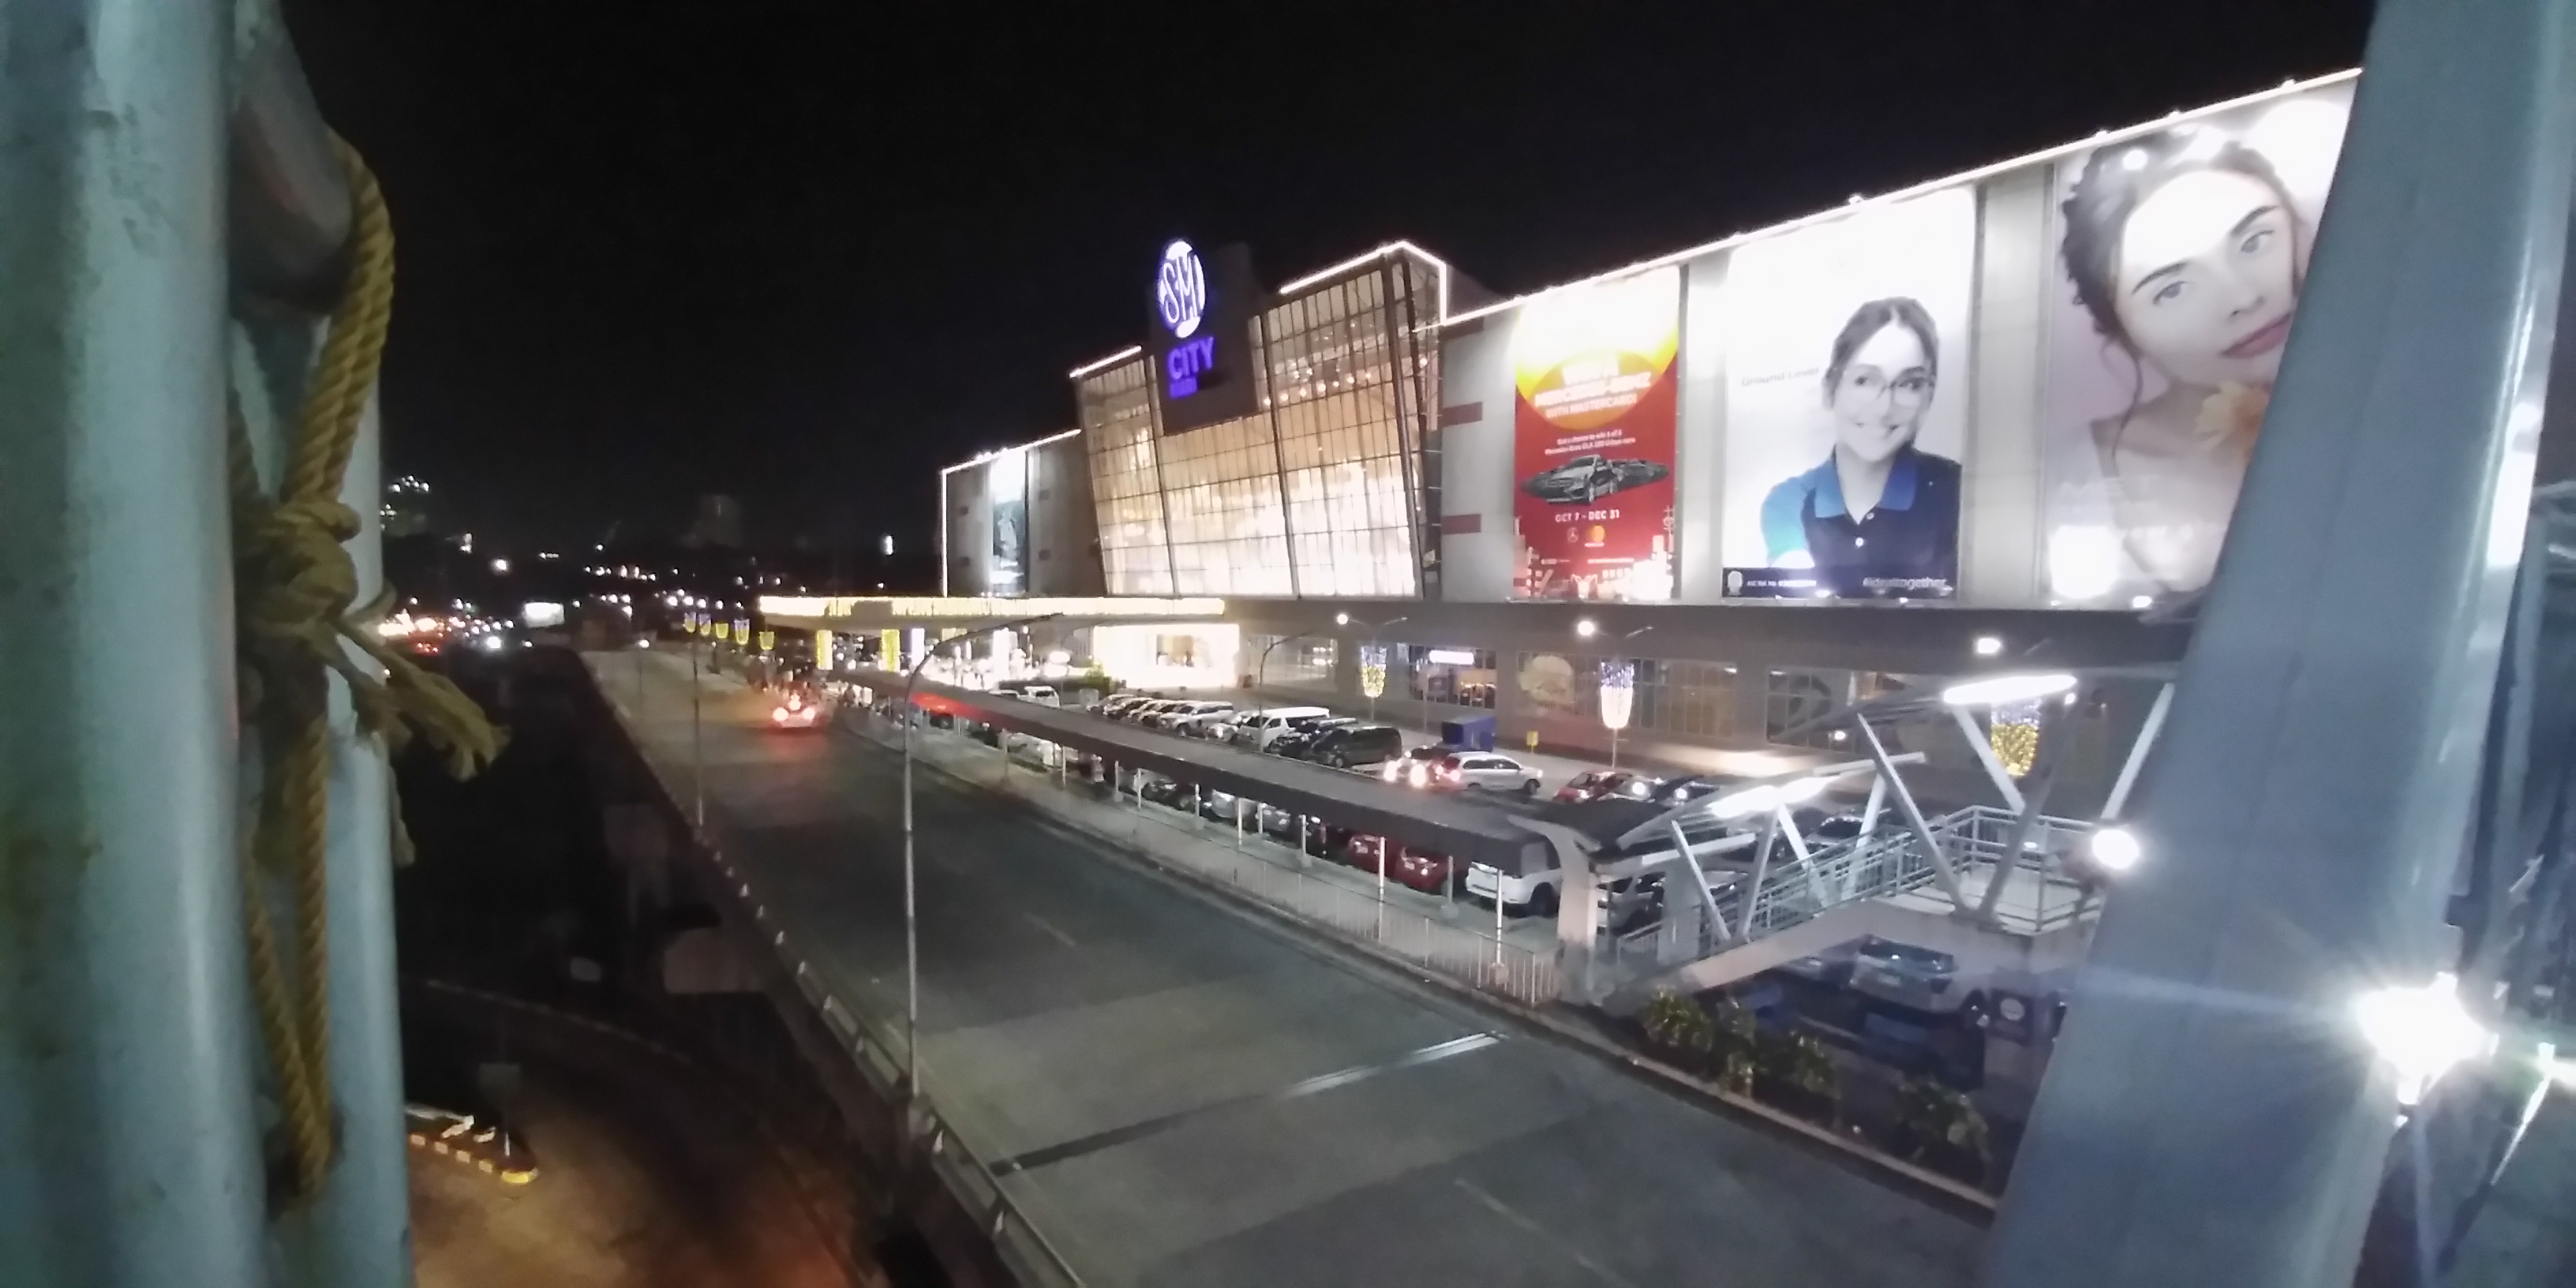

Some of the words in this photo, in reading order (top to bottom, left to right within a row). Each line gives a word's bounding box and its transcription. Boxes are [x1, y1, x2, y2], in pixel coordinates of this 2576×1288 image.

[1160, 248, 1201, 328] SM
[1168, 336, 1215, 380] CITY
[1555, 513, 1572, 522] OCT
[1588, 510, 1607, 520] DEC
